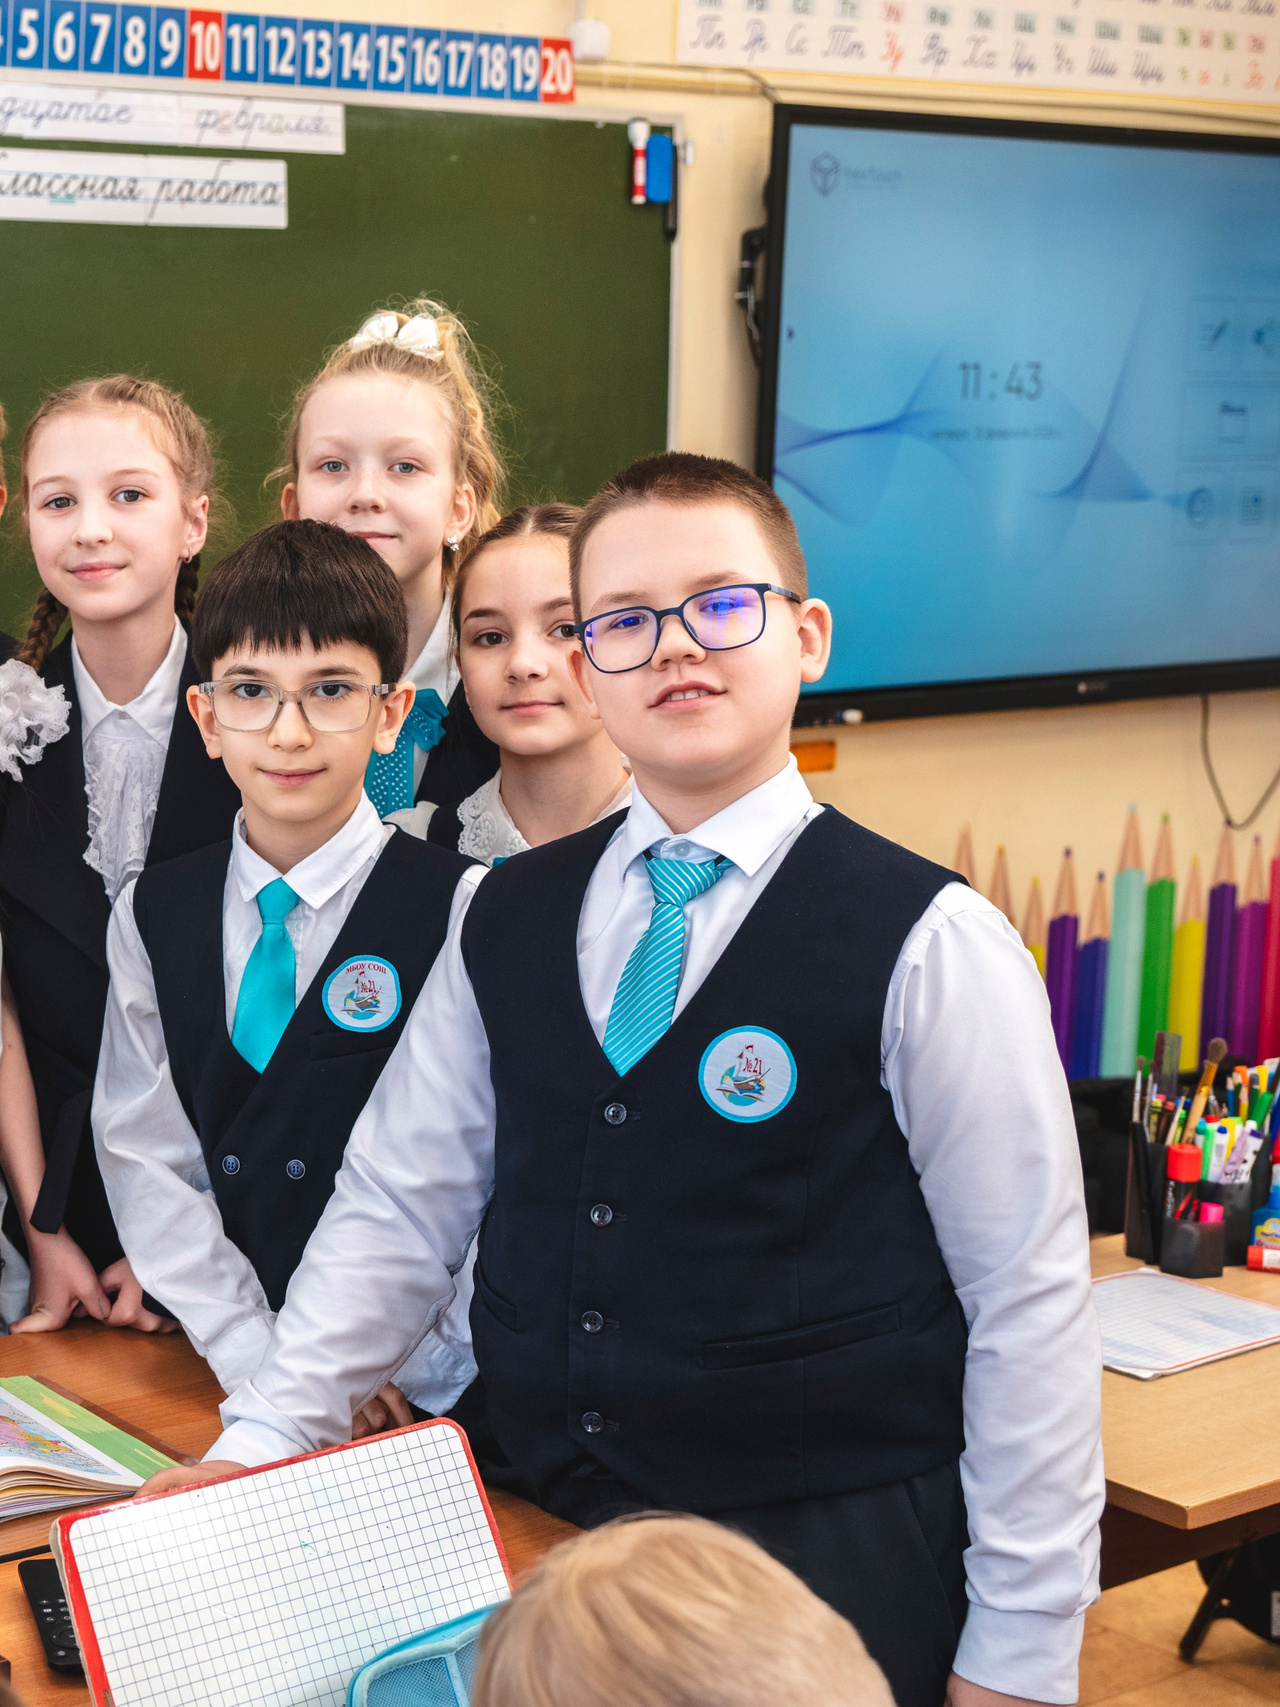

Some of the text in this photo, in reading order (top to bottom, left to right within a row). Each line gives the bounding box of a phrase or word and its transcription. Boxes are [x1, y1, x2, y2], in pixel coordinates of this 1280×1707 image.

[17, 8, 39, 60] 5
[53, 11, 76, 63] 6
[89, 13, 112, 65] 7
[124, 16, 146, 67] 8
[159, 18, 181, 69] 9
[191, 21, 220, 71] 10
[227, 23, 257, 73] 11
[265, 26, 296, 76] 12
[302, 28, 332, 79] 13
[339, 32, 371, 81] 14
[376, 35, 407, 84] 15
[411, 38, 442, 86] 16
[445, 40, 475, 88] 17
[477, 43, 508, 91] 18
[510, 46, 539, 92] 19
[540, 48, 572, 94] 20
[148, 159, 286, 220] работа
[958, 360, 1043, 401] 11:43
[345, 962, 387, 975] МБОУ СОШ
